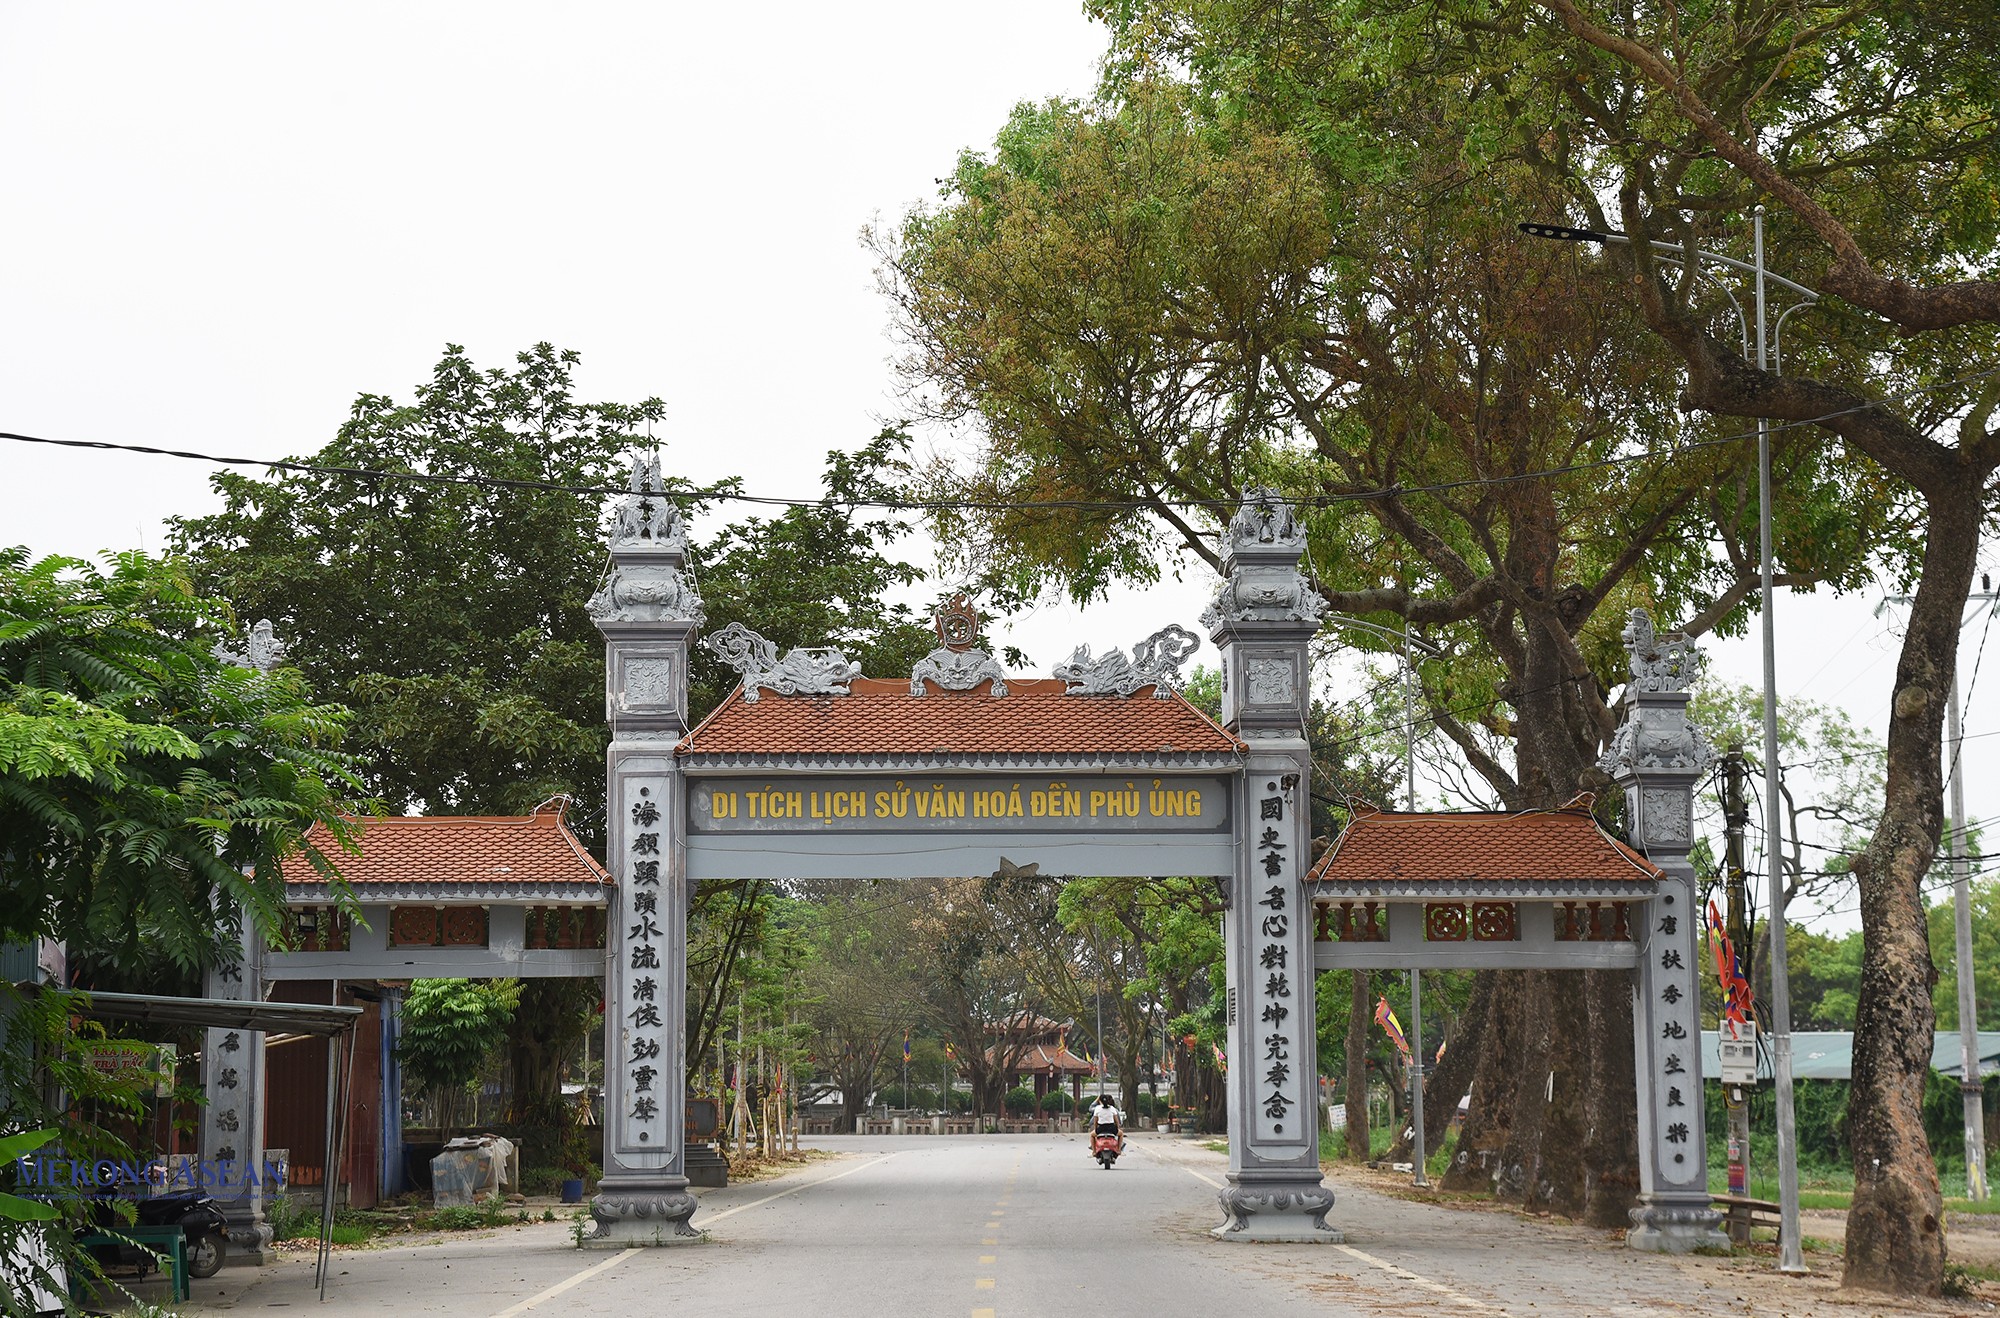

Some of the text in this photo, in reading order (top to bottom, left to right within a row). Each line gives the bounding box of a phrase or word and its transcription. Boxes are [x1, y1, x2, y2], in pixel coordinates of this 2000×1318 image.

[711, 779, 1202, 825] DI TÍCH LỊCH SỬ VĂN HOÁ ĐỀN PHÙ ỦNG
